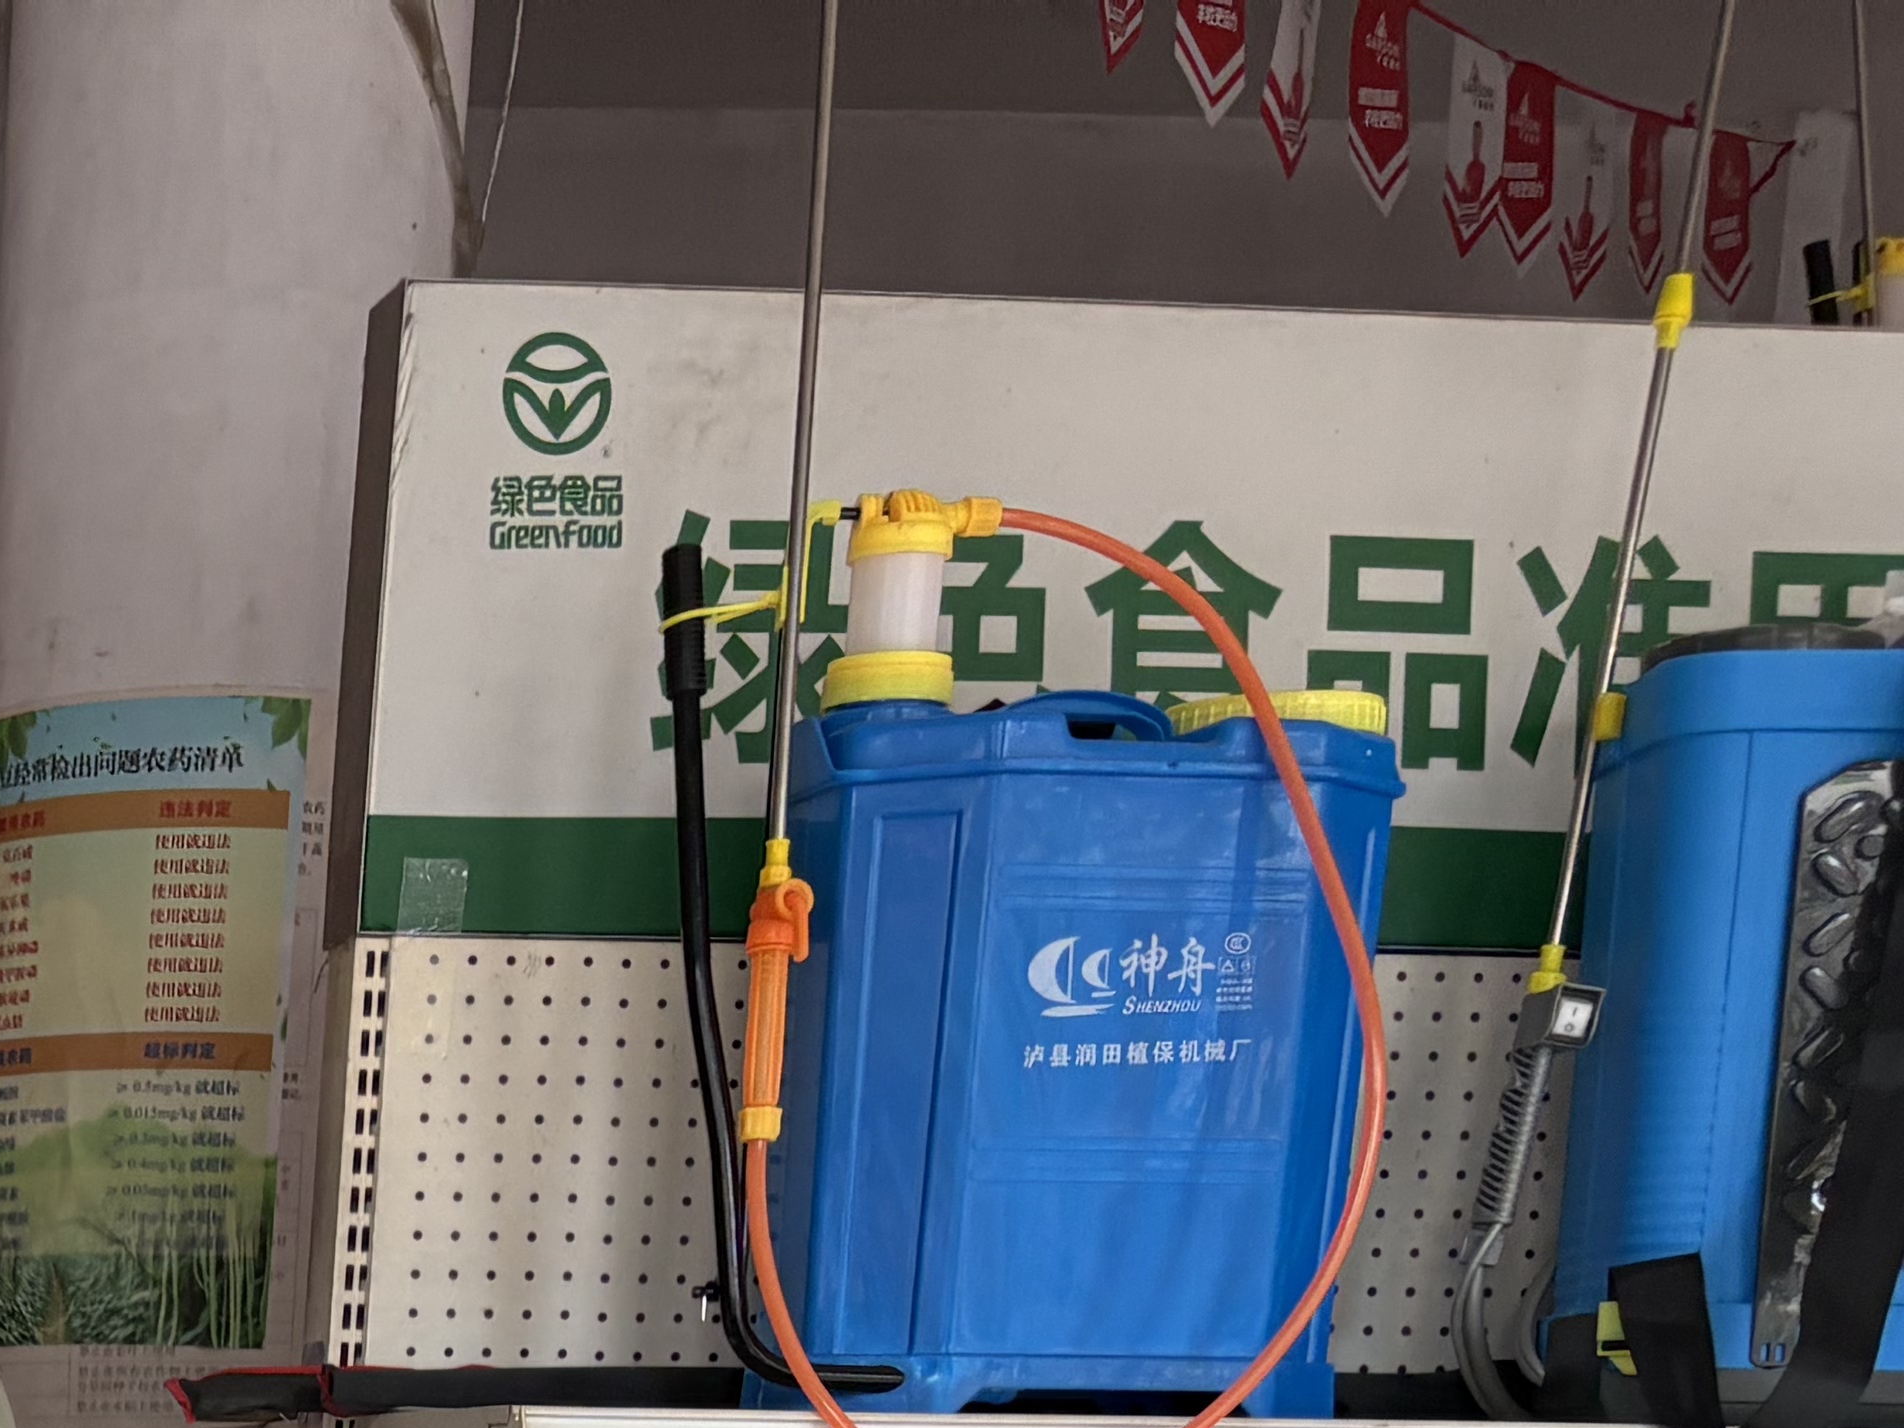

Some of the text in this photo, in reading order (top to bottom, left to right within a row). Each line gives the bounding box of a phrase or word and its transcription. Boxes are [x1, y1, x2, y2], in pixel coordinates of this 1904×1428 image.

[490, 474, 624, 518] 绿色食品
[159, 799, 232, 819] 违法判定
[1119, 933, 1218, 997] 神舟
[1122, 996, 1201, 1016] SHENZHOU
[1024, 1038, 1253, 1069] 泸县润田植保机械厂
